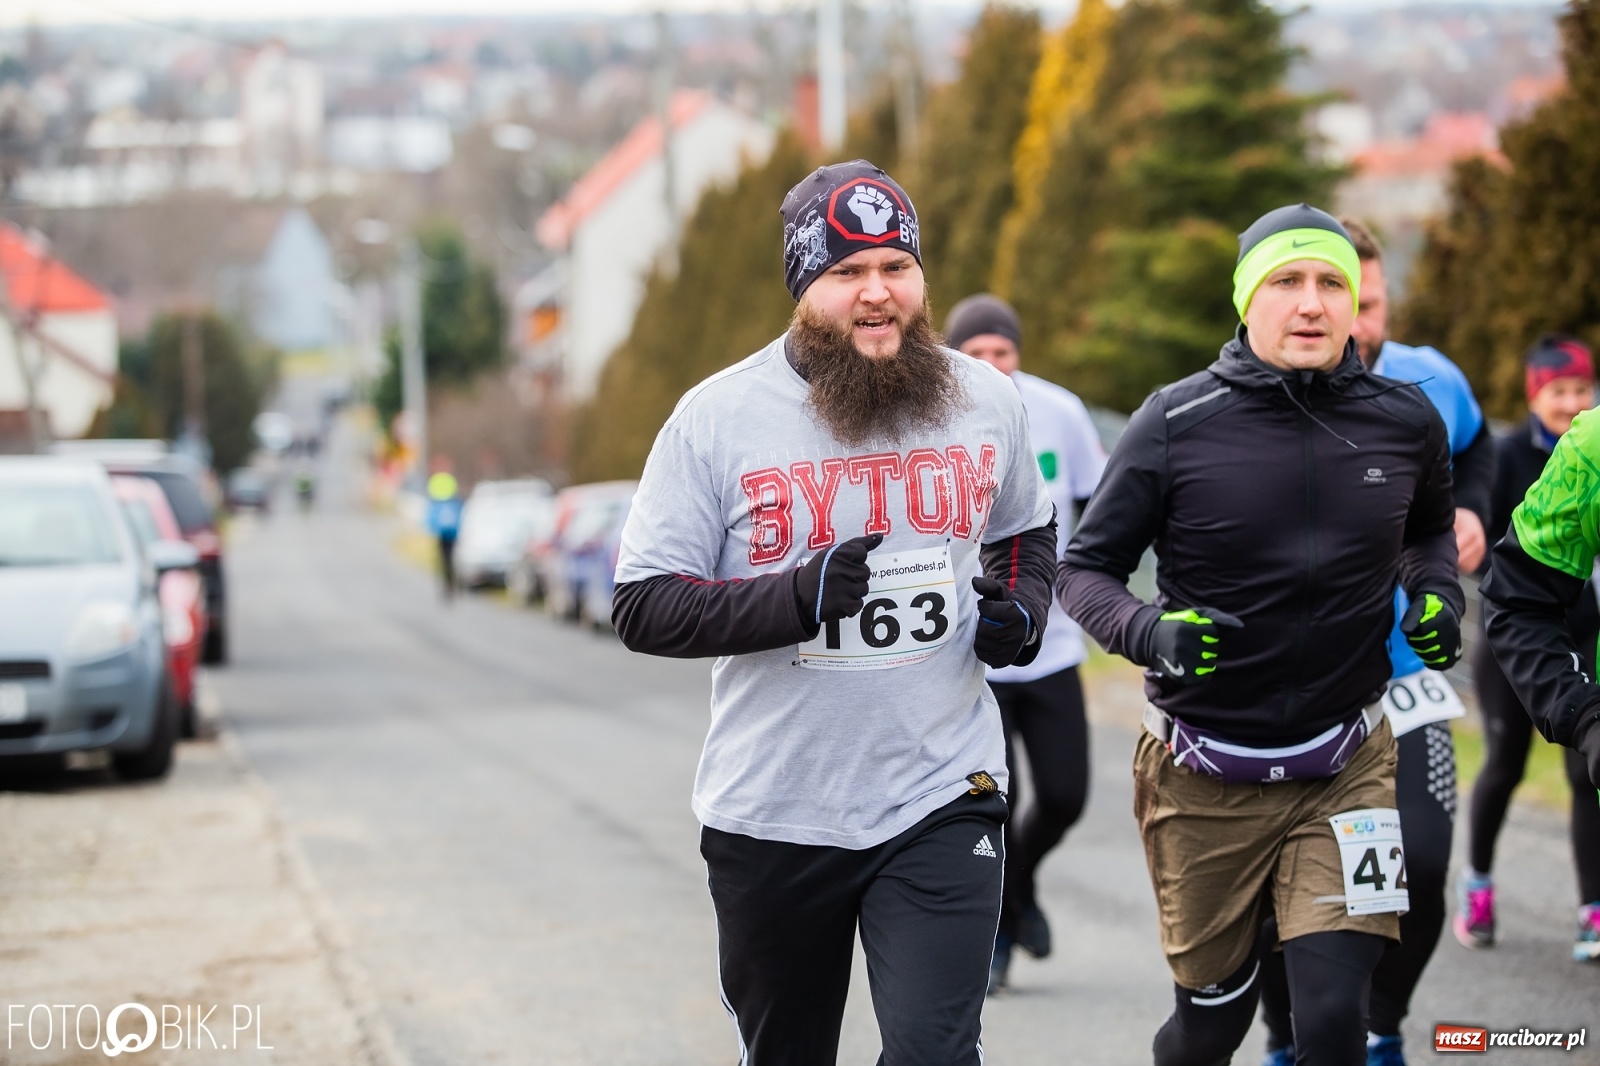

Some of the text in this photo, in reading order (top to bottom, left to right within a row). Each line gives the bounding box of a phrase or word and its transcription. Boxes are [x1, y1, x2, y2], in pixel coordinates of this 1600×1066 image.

[741, 444, 998, 566] BYTOM
[825, 592, 949, 649] 163
[973, 848, 996, 858] adidas
